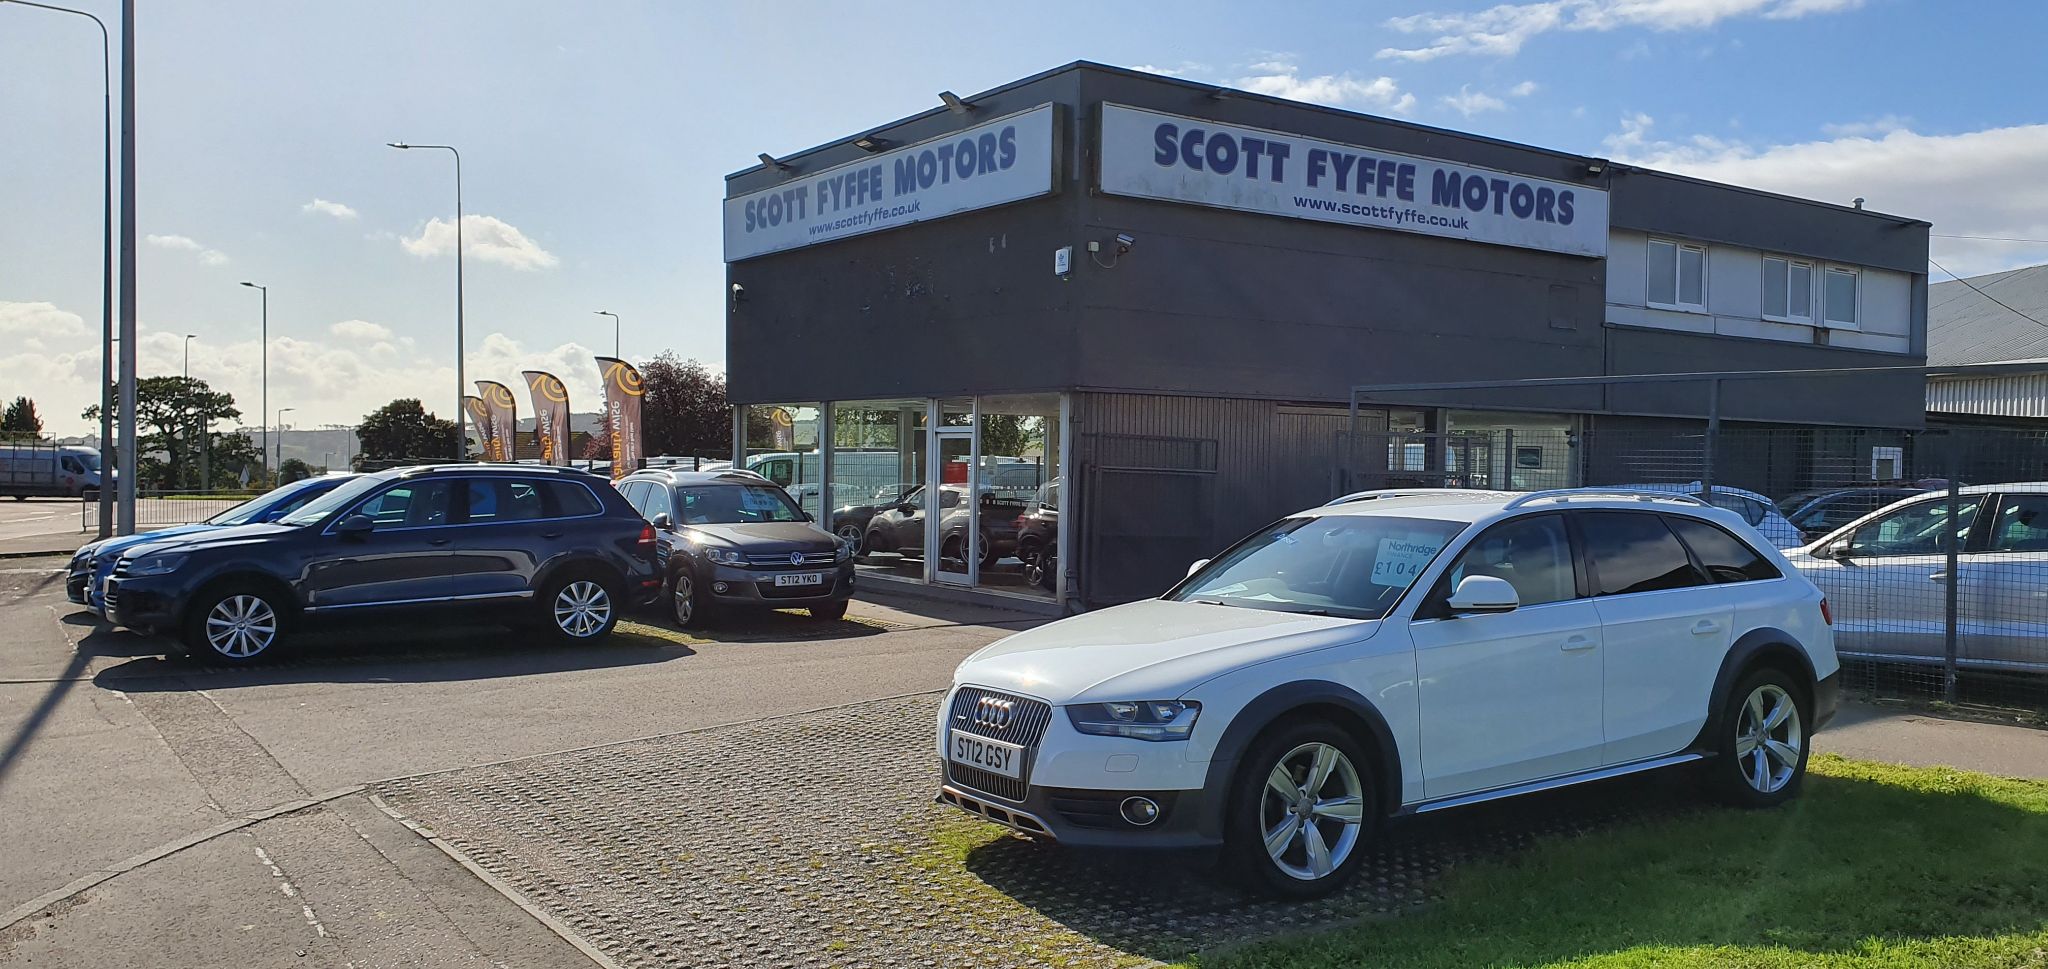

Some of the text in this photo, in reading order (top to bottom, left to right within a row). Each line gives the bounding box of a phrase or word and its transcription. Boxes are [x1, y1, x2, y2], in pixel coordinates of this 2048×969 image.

[745, 125, 1017, 233] SCOTT FYFFE MOTORS
[1153, 123, 1575, 226] SCOTT FYFFE MOTORS
[808, 200, 921, 236] www.scottfyffe.co.uk
[1293, 196, 1469, 231] www.scottfyffe.co.uk
[1388, 541, 1437, 557] Northridge
[781, 575, 800, 584] ST12
[957, 737, 1012, 771] ST12 GSY
